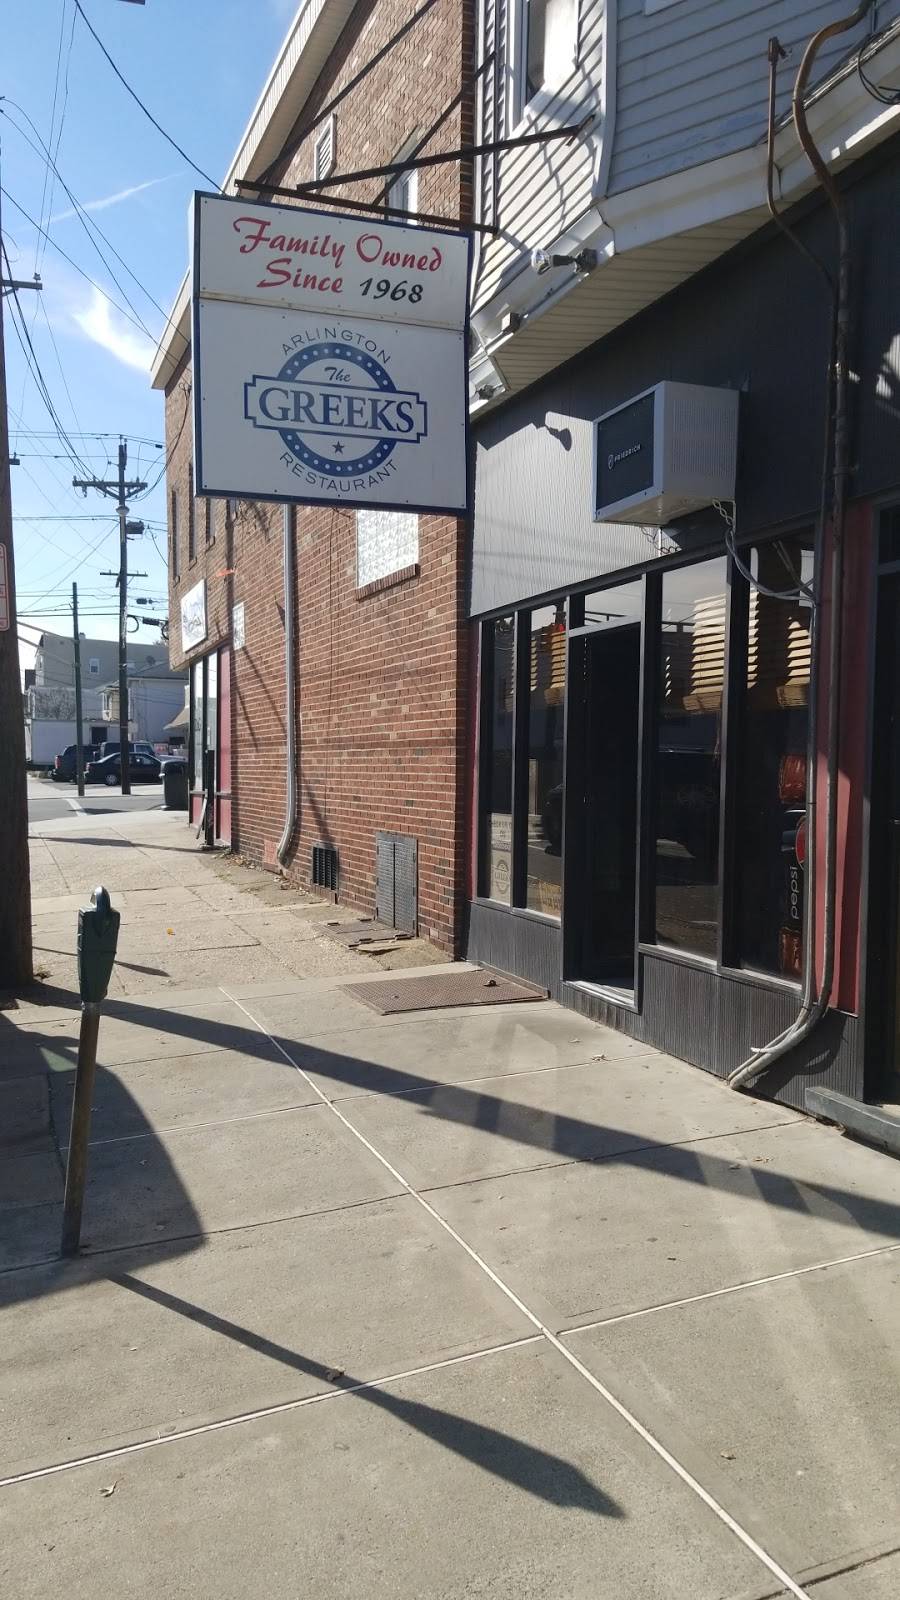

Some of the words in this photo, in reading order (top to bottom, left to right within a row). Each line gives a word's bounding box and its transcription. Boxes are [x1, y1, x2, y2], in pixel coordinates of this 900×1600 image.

[233, 217, 346, 268] Family
[356, 234, 442, 271] Owned
[257, 258, 344, 293] Since
[360, 278, 424, 304] 1968
[281, 328, 391, 364] ARLINGTON
[324, 367, 352, 383] The
[258, 388, 415, 433] GREEKS
[280, 453, 398, 493] RESTAURANT
[790, 866, 799, 919] pepsi
